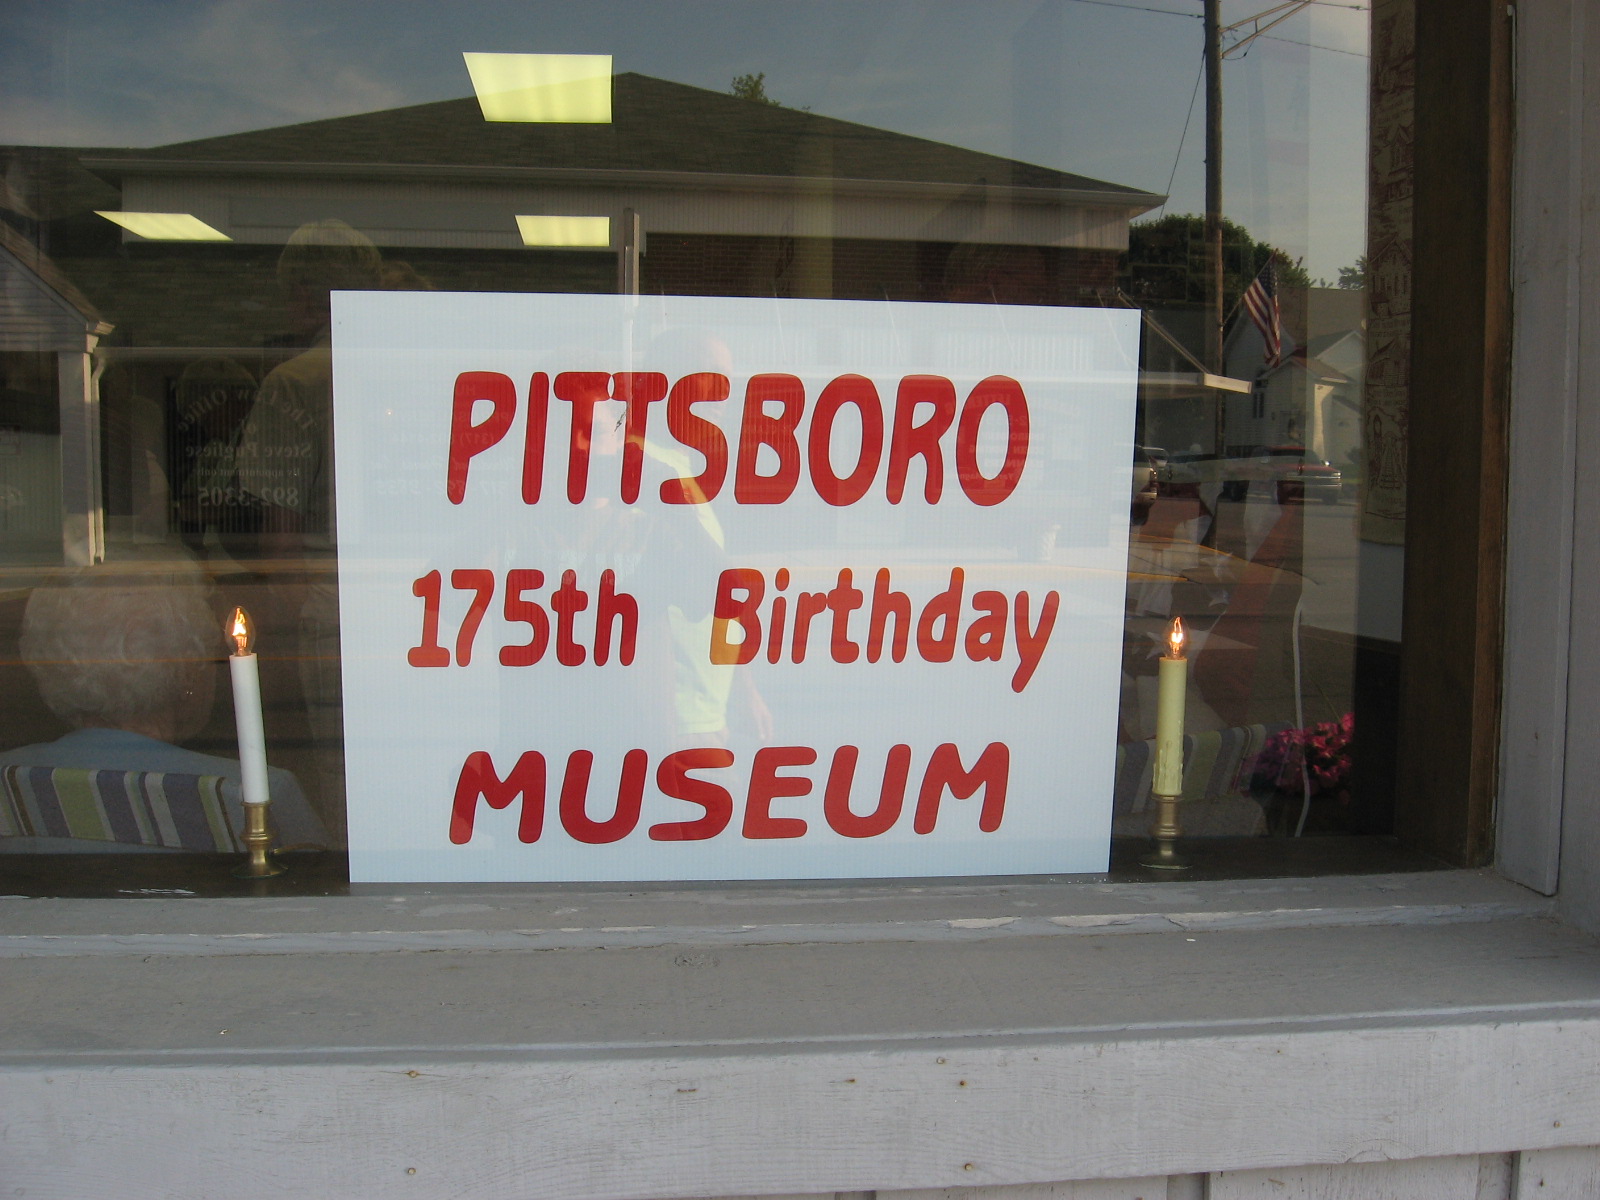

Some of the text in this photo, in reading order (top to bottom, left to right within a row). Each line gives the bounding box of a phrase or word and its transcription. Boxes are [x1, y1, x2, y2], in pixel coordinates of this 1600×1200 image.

[448, 371, 1030, 507] PITTSBORO
[408, 567, 1060, 693] 175th Birthday
[450, 742, 1010, 844] MUSEUM
